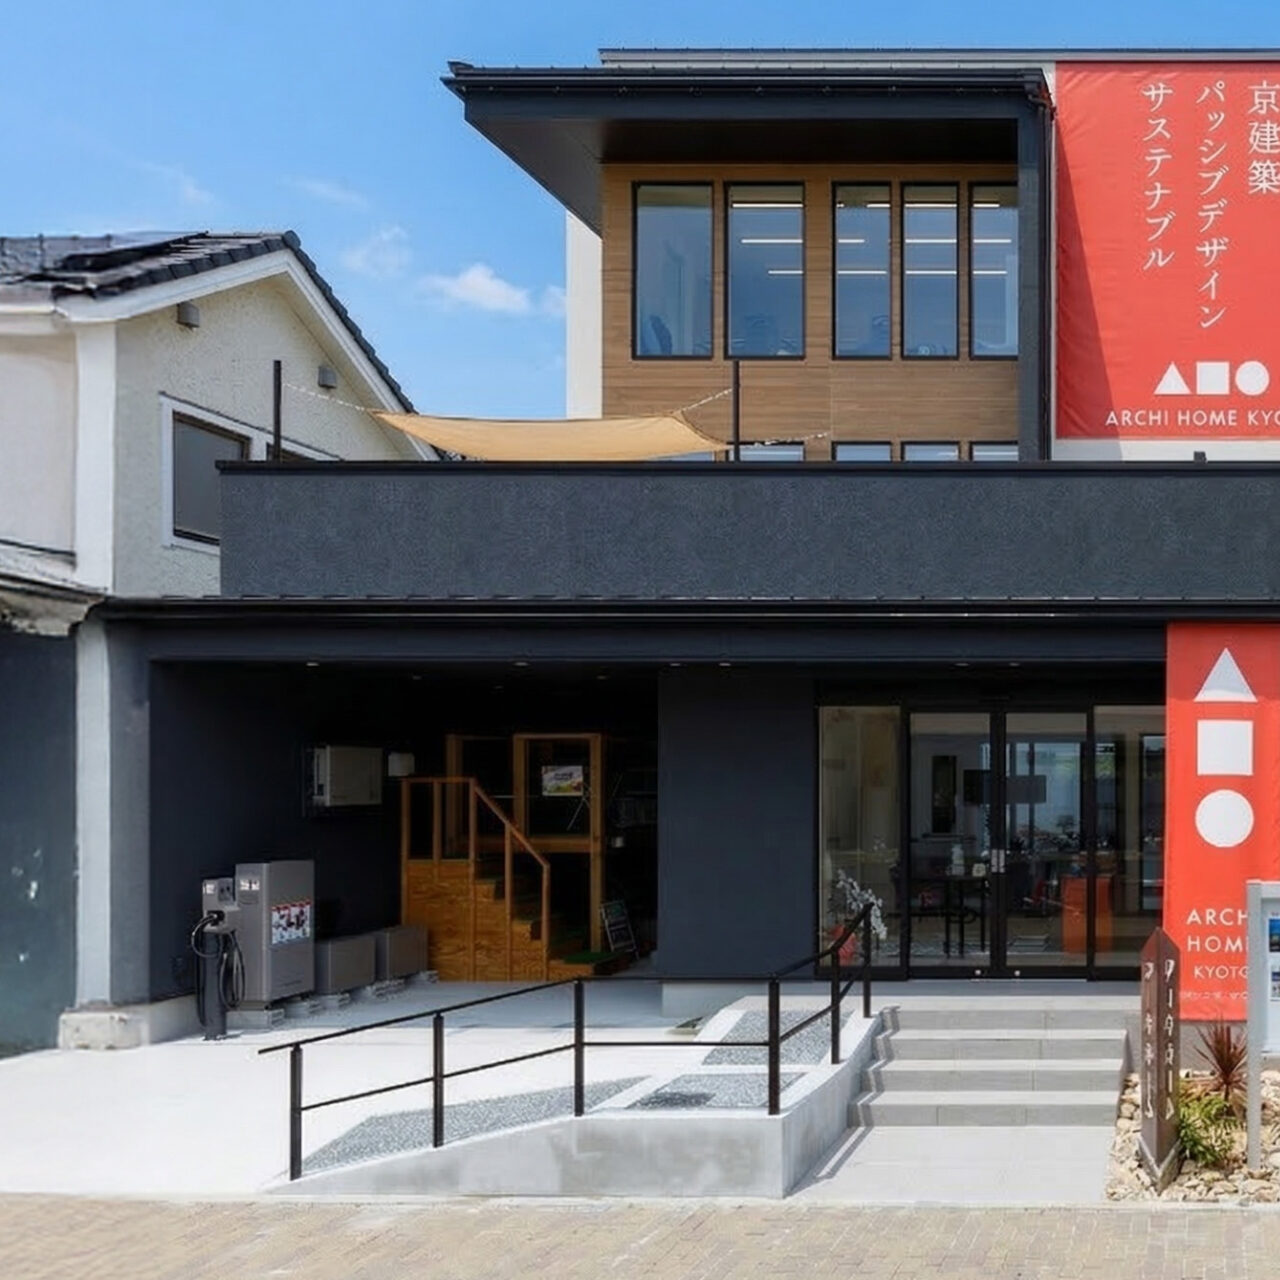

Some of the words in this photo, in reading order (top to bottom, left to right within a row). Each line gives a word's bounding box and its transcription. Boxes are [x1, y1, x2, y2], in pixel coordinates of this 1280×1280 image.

[1142, 82, 1176, 271] サステナブル
[1195, 80, 1229, 328] パッシブデザイン
[1105, 409, 1169, 426] ARCHI
[1178, 409, 1238, 426] HOME
[1187, 935, 1249, 953] HOM
